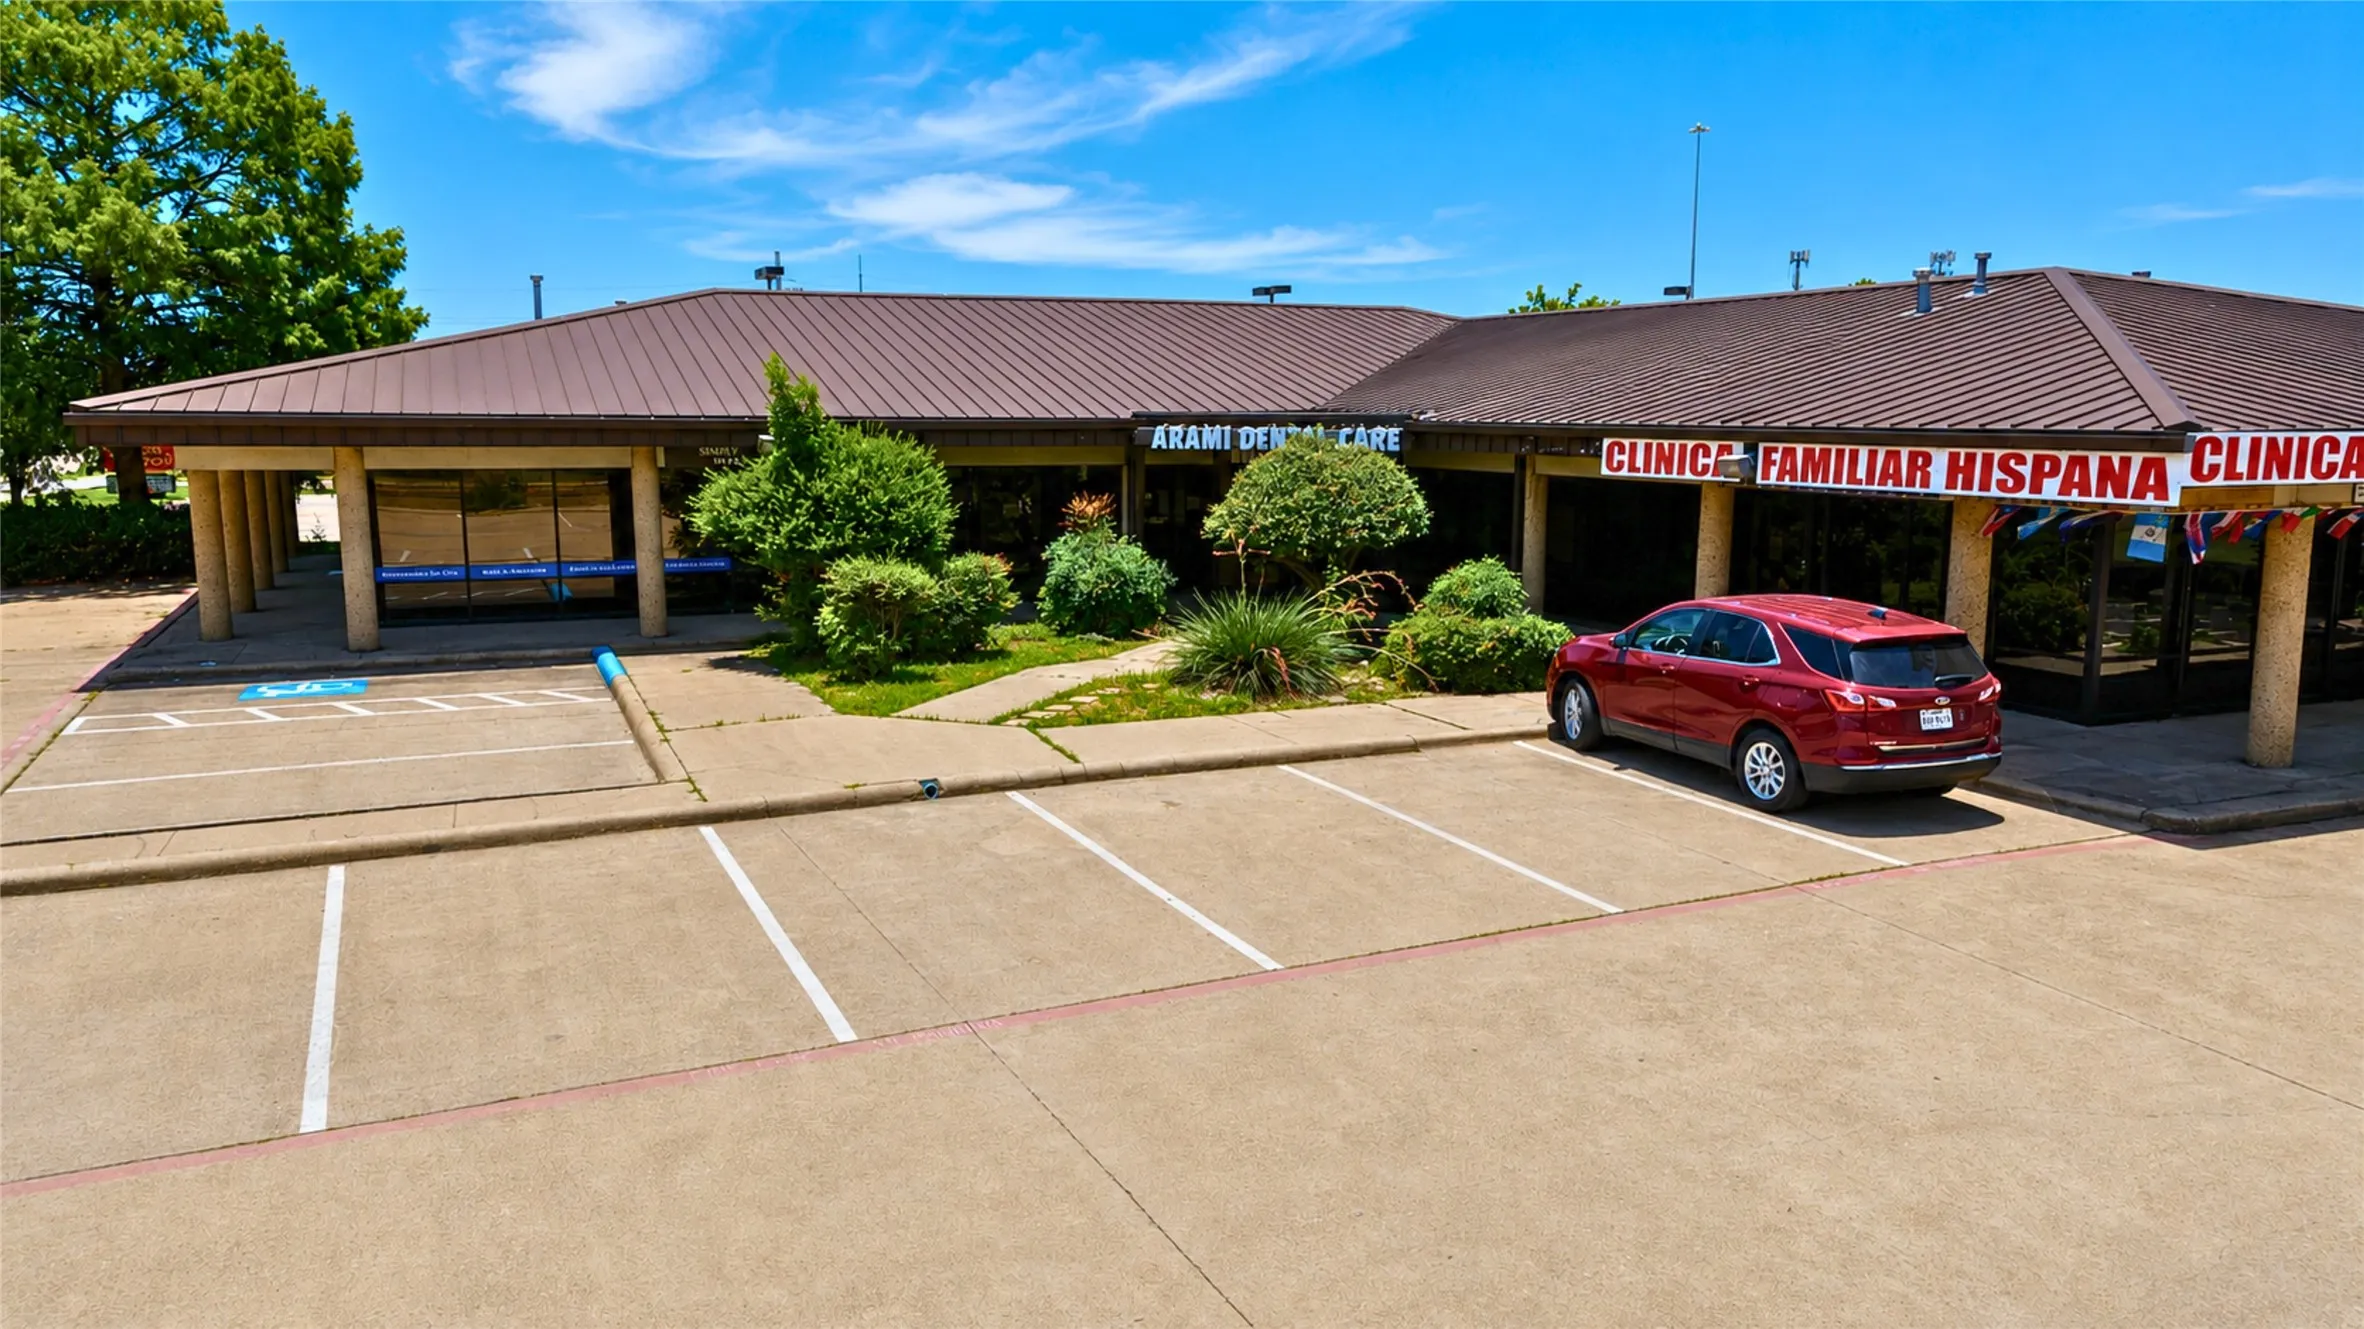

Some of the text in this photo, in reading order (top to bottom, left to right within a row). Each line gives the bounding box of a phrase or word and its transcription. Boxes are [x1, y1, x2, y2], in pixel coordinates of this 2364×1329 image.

[1151, 425, 1231, 450] ARAMI
[1338, 427, 1402, 452] CARE
[2190, 436, 2364, 481] CLINICA
[1761, 446, 1932, 489] FAMILIAR
[1945, 451, 2169, 501] HISPANA
